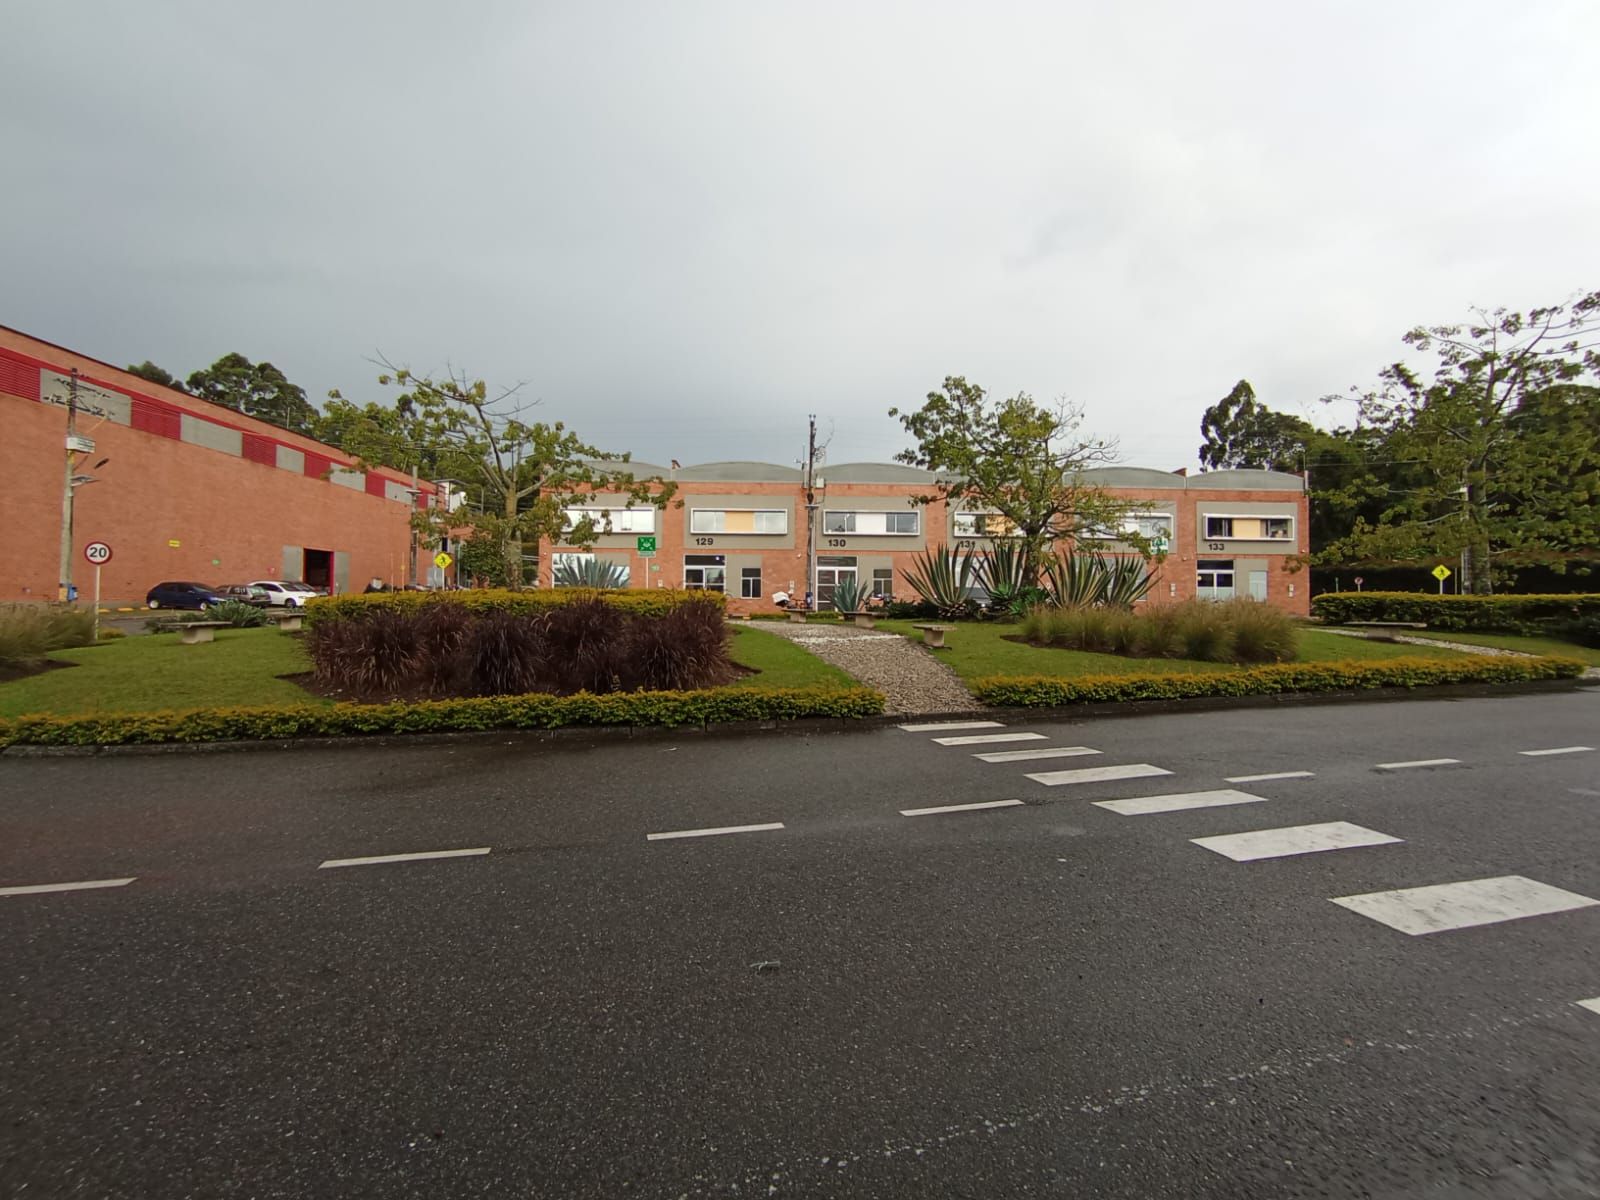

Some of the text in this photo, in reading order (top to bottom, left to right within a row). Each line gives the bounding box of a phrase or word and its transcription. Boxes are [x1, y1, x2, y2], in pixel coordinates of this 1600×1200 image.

[695, 537, 714, 546] 129
[828, 538, 846, 547] 130
[1208, 543, 1225, 551] 133
[89, 546, 108, 558] 20
